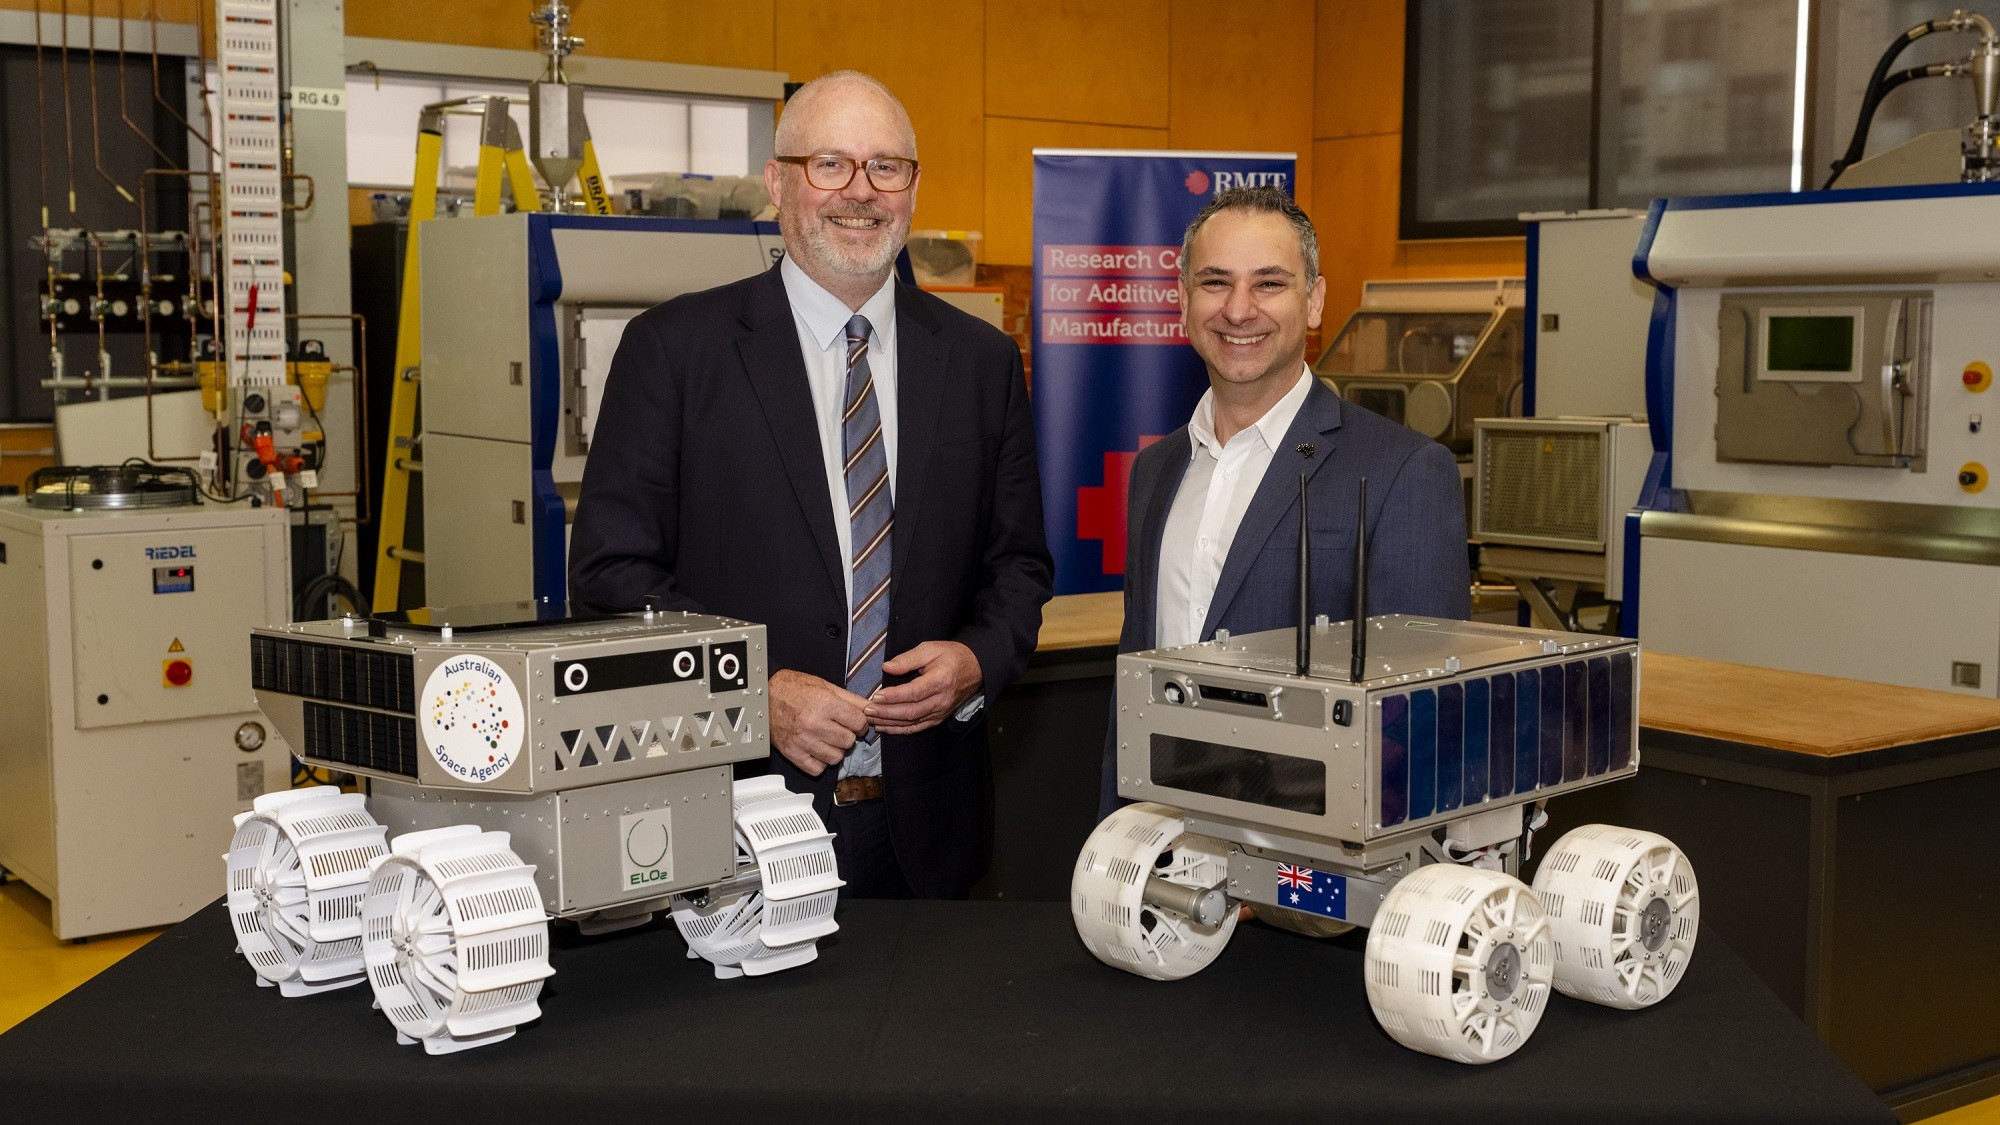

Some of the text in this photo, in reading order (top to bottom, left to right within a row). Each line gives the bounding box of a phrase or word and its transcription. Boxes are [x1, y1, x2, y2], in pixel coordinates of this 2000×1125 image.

[299, 92, 340, 106] RG 4.9
[1213, 171, 1287, 193] RMIT
[1050, 249, 1152, 269] Research
[1050, 283, 1179, 303] for Additive
[1049, 317, 1188, 338] Manufacturi
[444, 659, 502, 684] Australian
[435, 744, 511, 781] Space Agency
